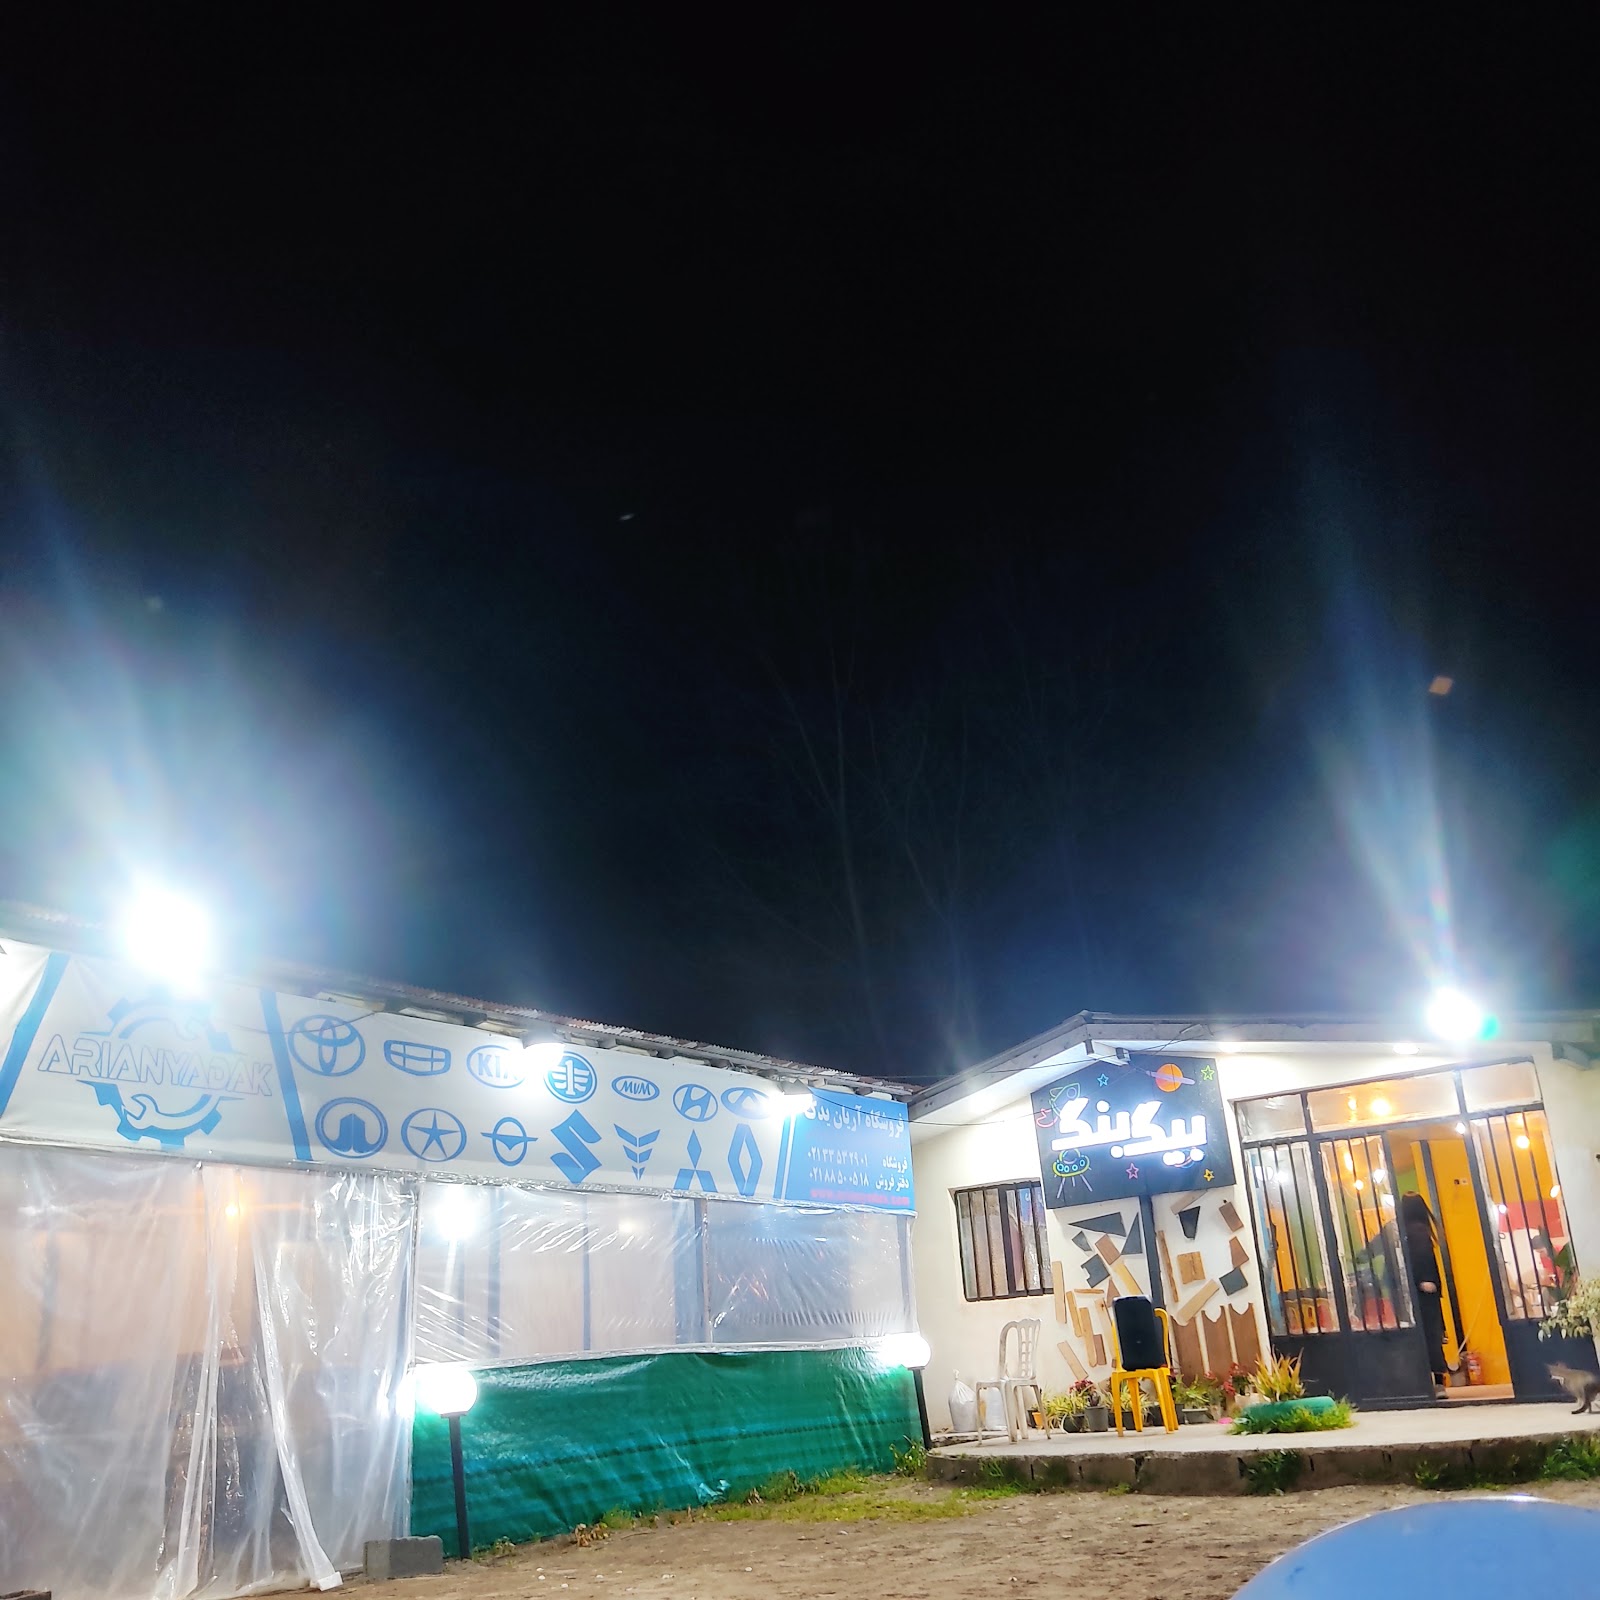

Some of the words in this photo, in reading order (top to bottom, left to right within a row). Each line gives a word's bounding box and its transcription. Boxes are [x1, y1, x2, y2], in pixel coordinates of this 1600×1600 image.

[37, 1033, 273, 1097] ARIANYADAK
[619, 1080, 652, 1096] MVM
[865, 1109, 904, 1138] فروشگاه
